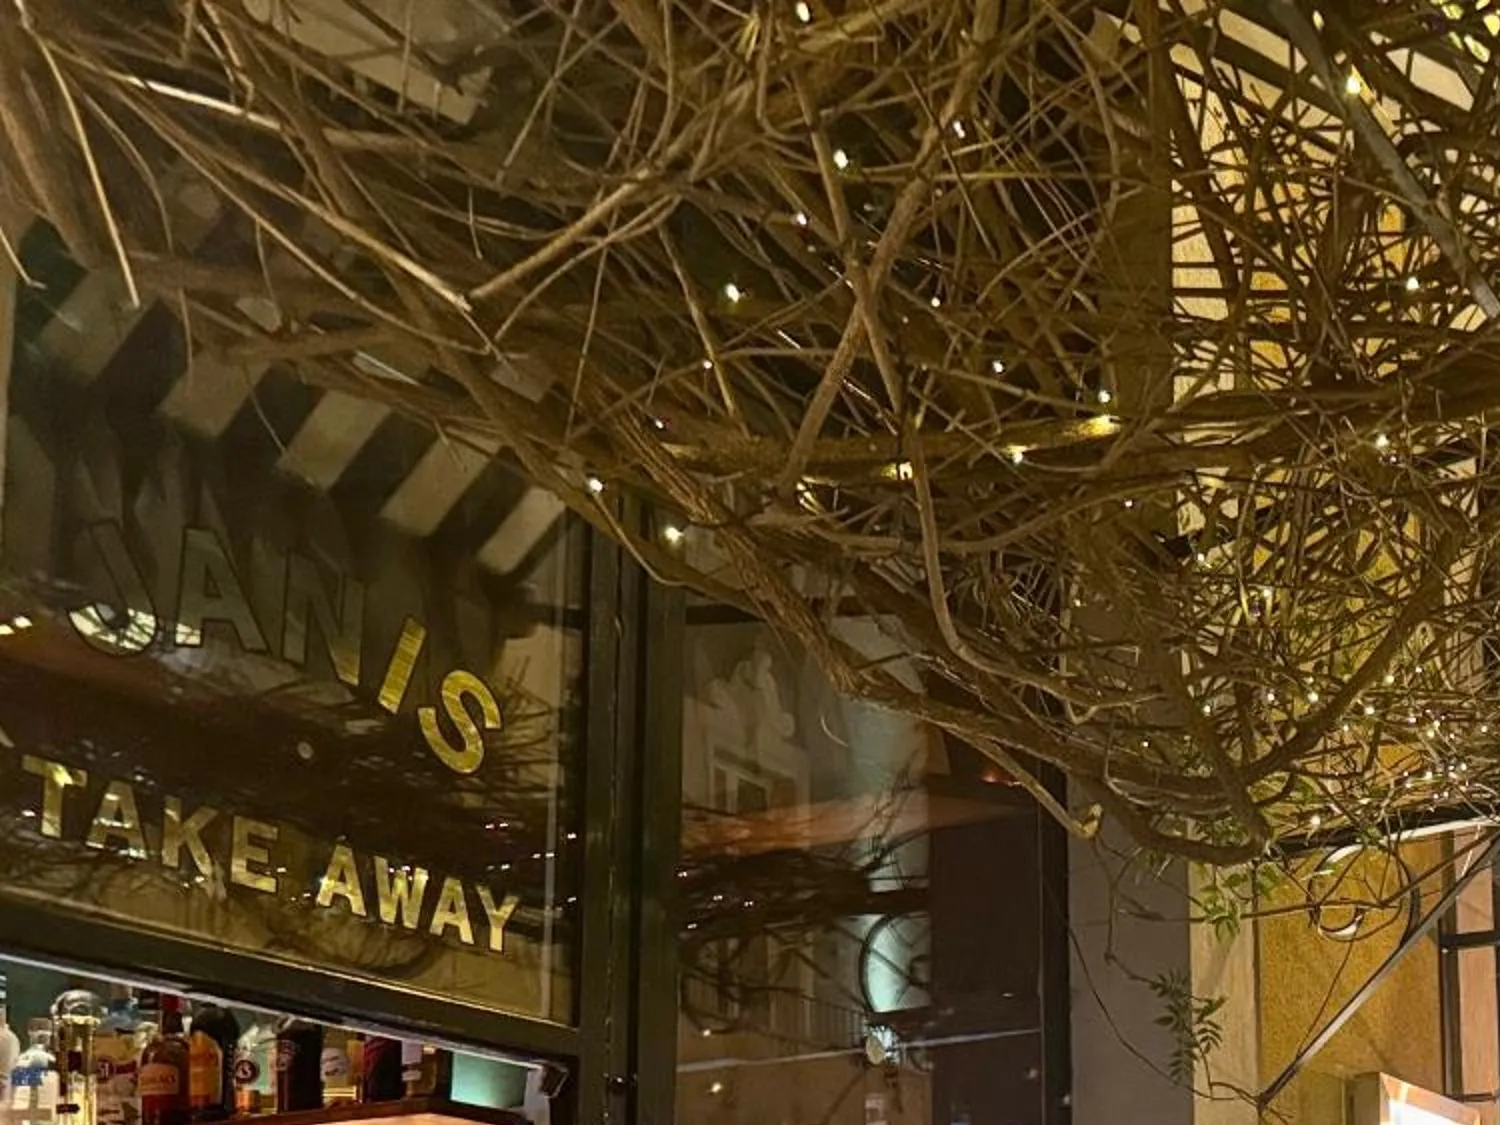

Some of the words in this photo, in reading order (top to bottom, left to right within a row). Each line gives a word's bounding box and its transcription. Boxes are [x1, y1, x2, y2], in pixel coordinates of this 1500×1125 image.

[68, 519, 503, 775] JANIS
[22, 753, 279, 894] TAKE
[316, 843, 520, 952] AWAY
